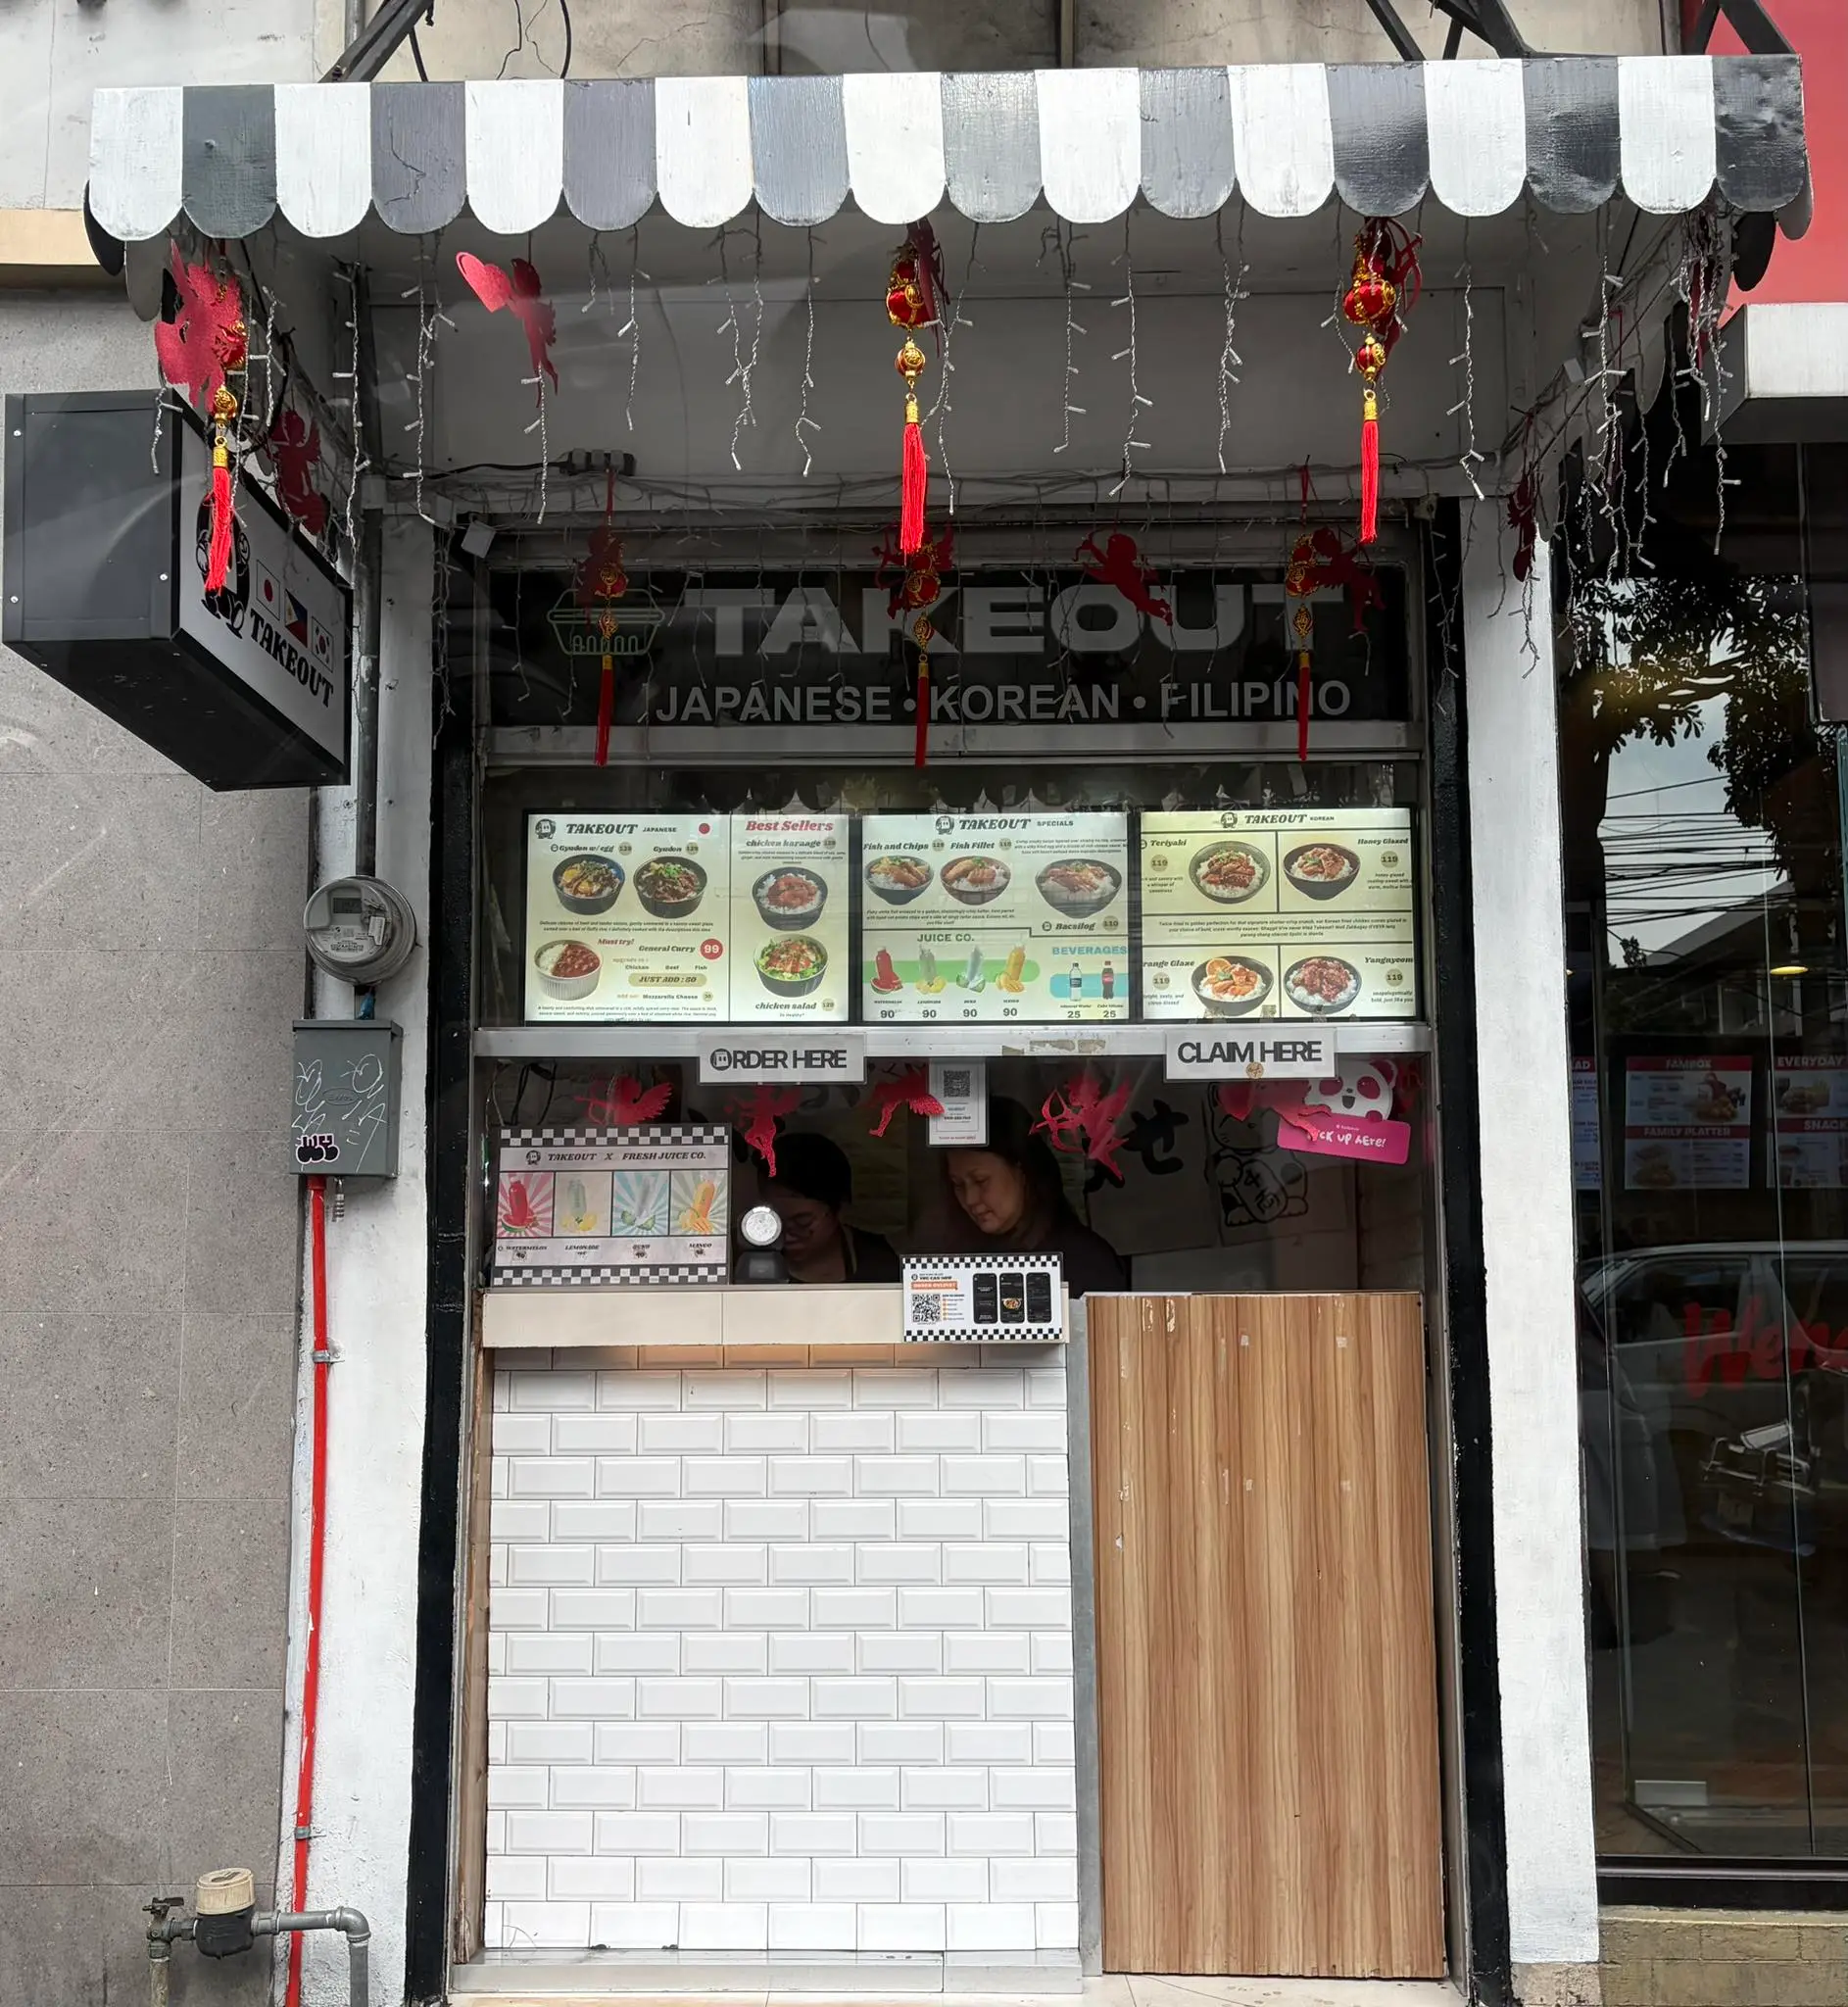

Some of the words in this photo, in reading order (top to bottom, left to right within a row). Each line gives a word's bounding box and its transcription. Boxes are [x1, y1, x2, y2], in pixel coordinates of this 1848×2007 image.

[684, 581, 1343, 657] TAKEOUT
[251, 609, 334, 708] TAKEOUT
[656, 685, 892, 723] JAPANESE
[930, 682, 1120, 721] KOREAN
[1160, 679, 1351, 719] FILIPINO
[959, 818, 1031, 830] TAKEOUT
[1244, 813, 1307, 824] TAKEOUT
[565, 823, 639, 835] TAKEOUT
[746, 820, 780, 832] Best
[781, 820, 834, 832] Sellers
[746, 839, 782, 848] chicken
[863, 843, 882, 853] Fish
[897, 842, 929, 852] Chips
[950, 842, 969, 851] Fish
[970, 841, 996, 850] Fillet
[1150, 838, 1187, 848] Teriyaki
[1054, 921, 1095, 932] Bacsilog
[917, 934, 951, 943] JUICE
[955, 933, 975, 942] CO.
[671, 945, 696, 954] Curry
[705, 943, 718, 955] 99
[1051, 946, 1128, 956] BEVERAGES
[1142, 959, 1170, 968] range
[754, 1002, 791, 1010] chicken
[791, 1002, 817, 1010] salad
[880, 1008, 896, 1019] 90
[922, 1008, 937, 1019] 90
[962, 1008, 978, 1018] 90
[1002, 1007, 1018, 1017] 90
[1067, 1010, 1081, 1019] 25
[1102, 1009, 1117, 1019] 25
[1178, 1041, 1255, 1063] CLAIM
[1259, 1041, 1322, 1062] HERE
[793, 1050, 847, 1069] HERE
[1573, 1060, 1591, 1070] AD
[1666, 1059, 1713, 1069] FAMBOX
[1777, 1056, 1843, 1067] EVERYDAY
[1643, 1127, 1683, 1137] FAMILY
[1684, 1127, 1731, 1137] PLATTER
[548, 1152, 597, 1162] TAKEOUT
[604, 1152, 614, 1161] X
[622, 1152, 657, 1161] FRESH
[657, 1152, 689, 1161] JUICE
[690, 1151, 706, 1160] CO.
